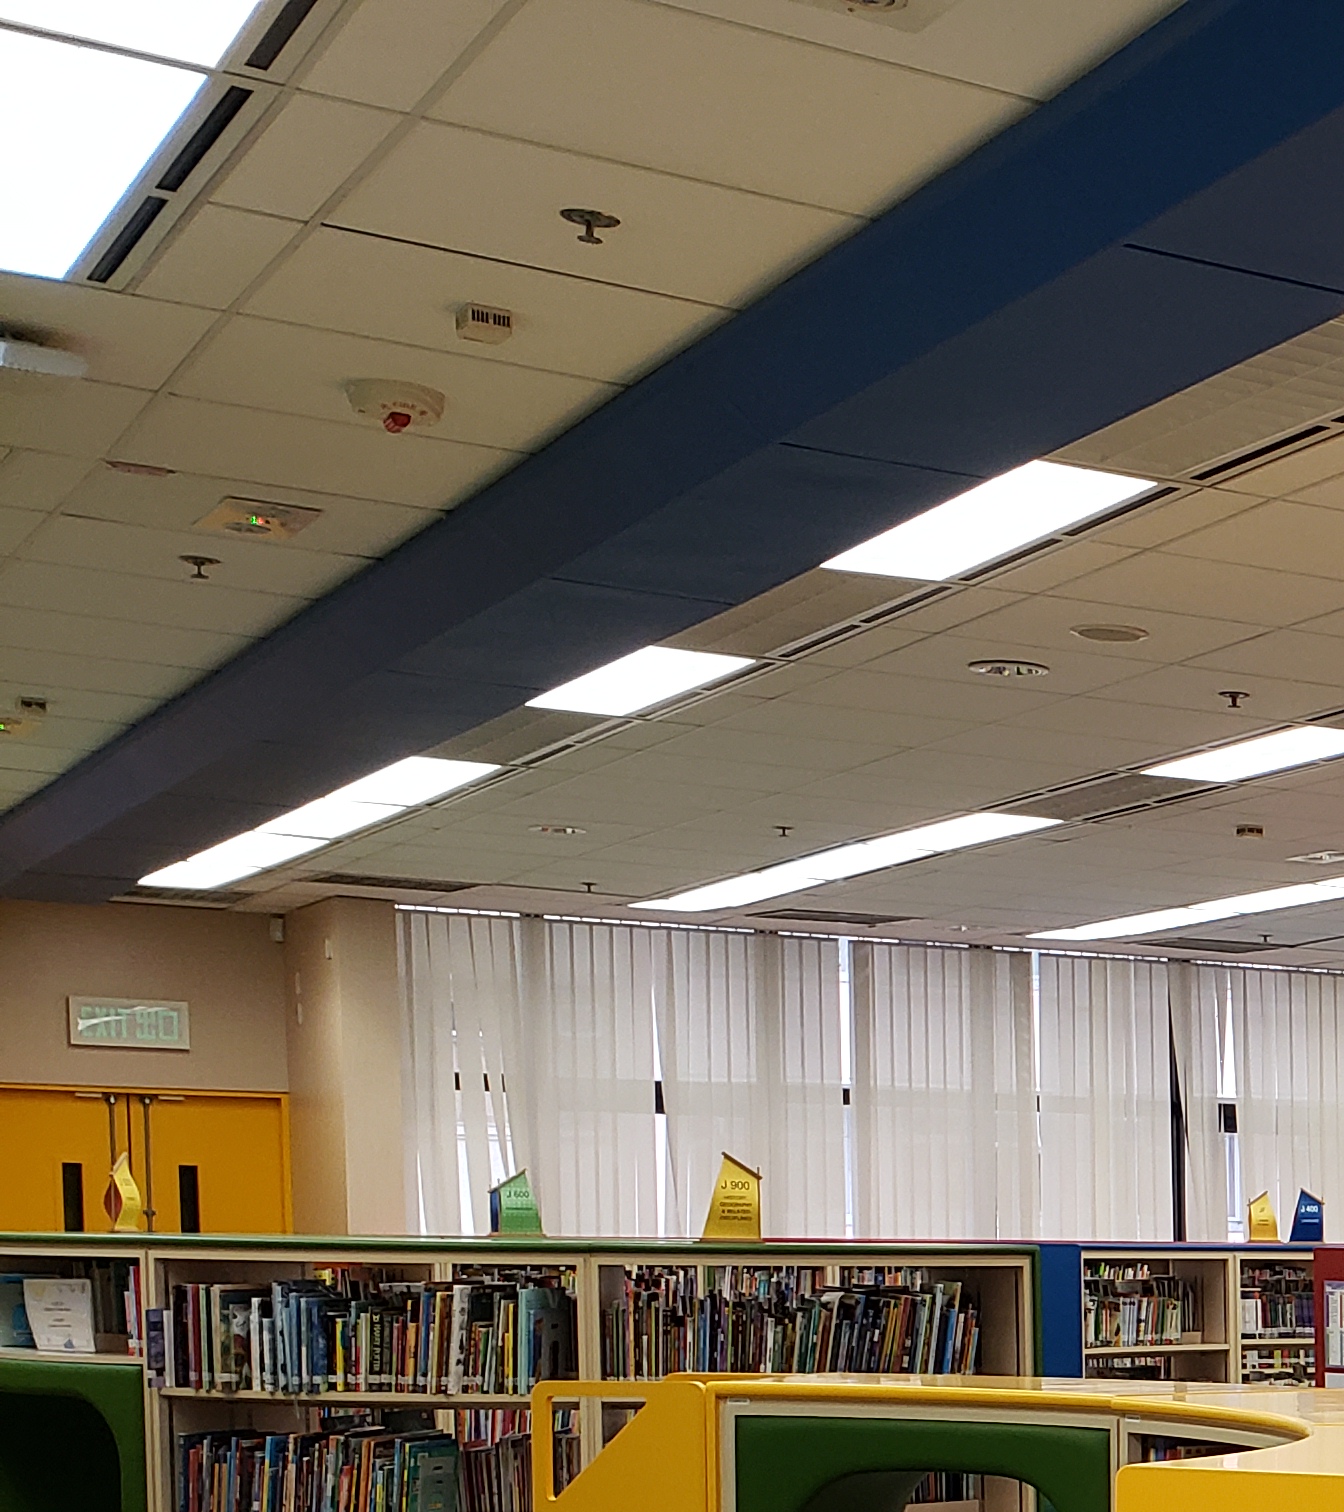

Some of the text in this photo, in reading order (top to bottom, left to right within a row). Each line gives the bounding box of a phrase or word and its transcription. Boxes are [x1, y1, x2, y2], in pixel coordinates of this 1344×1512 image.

[81, 1006, 127, 1038] EXIT
[136, 1008, 178, 1040] 出口
[730, 1181, 750, 1190] 900
